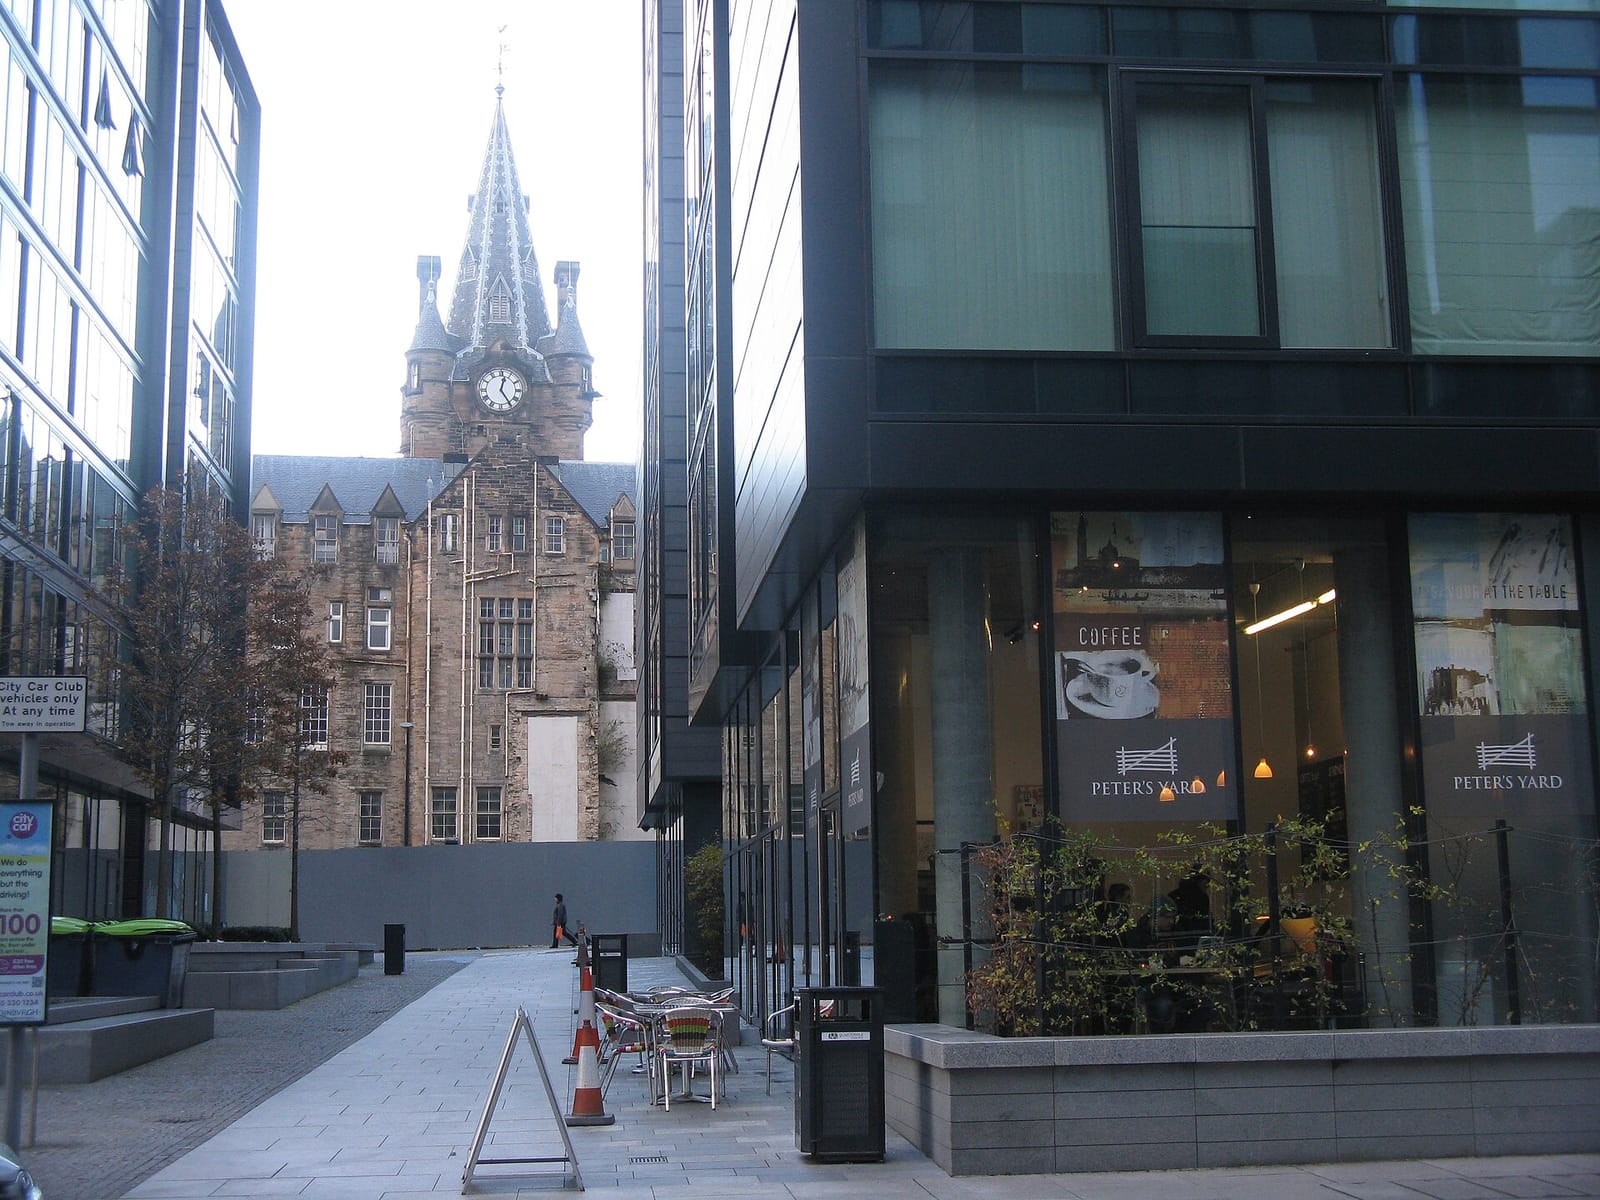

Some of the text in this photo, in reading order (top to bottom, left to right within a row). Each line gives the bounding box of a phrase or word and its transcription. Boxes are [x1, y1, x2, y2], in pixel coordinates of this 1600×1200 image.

[1483, 584, 1498, 599] AT
[1502, 584, 1524, 599] THE
[1528, 584, 1567, 599] TABLE
[1079, 626, 1142, 646] COFFEE
[0, 681, 83, 693] City Car Club
[0, 693, 79, 705] vehicles only
[2, 706, 76, 717] At any time
[1091, 780, 1207, 796] PETER'S YARD
[1453, 774, 1563, 790] PETER'S YARD
[13, 813, 35, 825] city
[13, 823, 33, 832] car
[0, 858, 28, 866] We do
[0, 869, 43, 878] everything
[0, 880, 29, 888] but the
[0, 890, 30, 900] driving!
